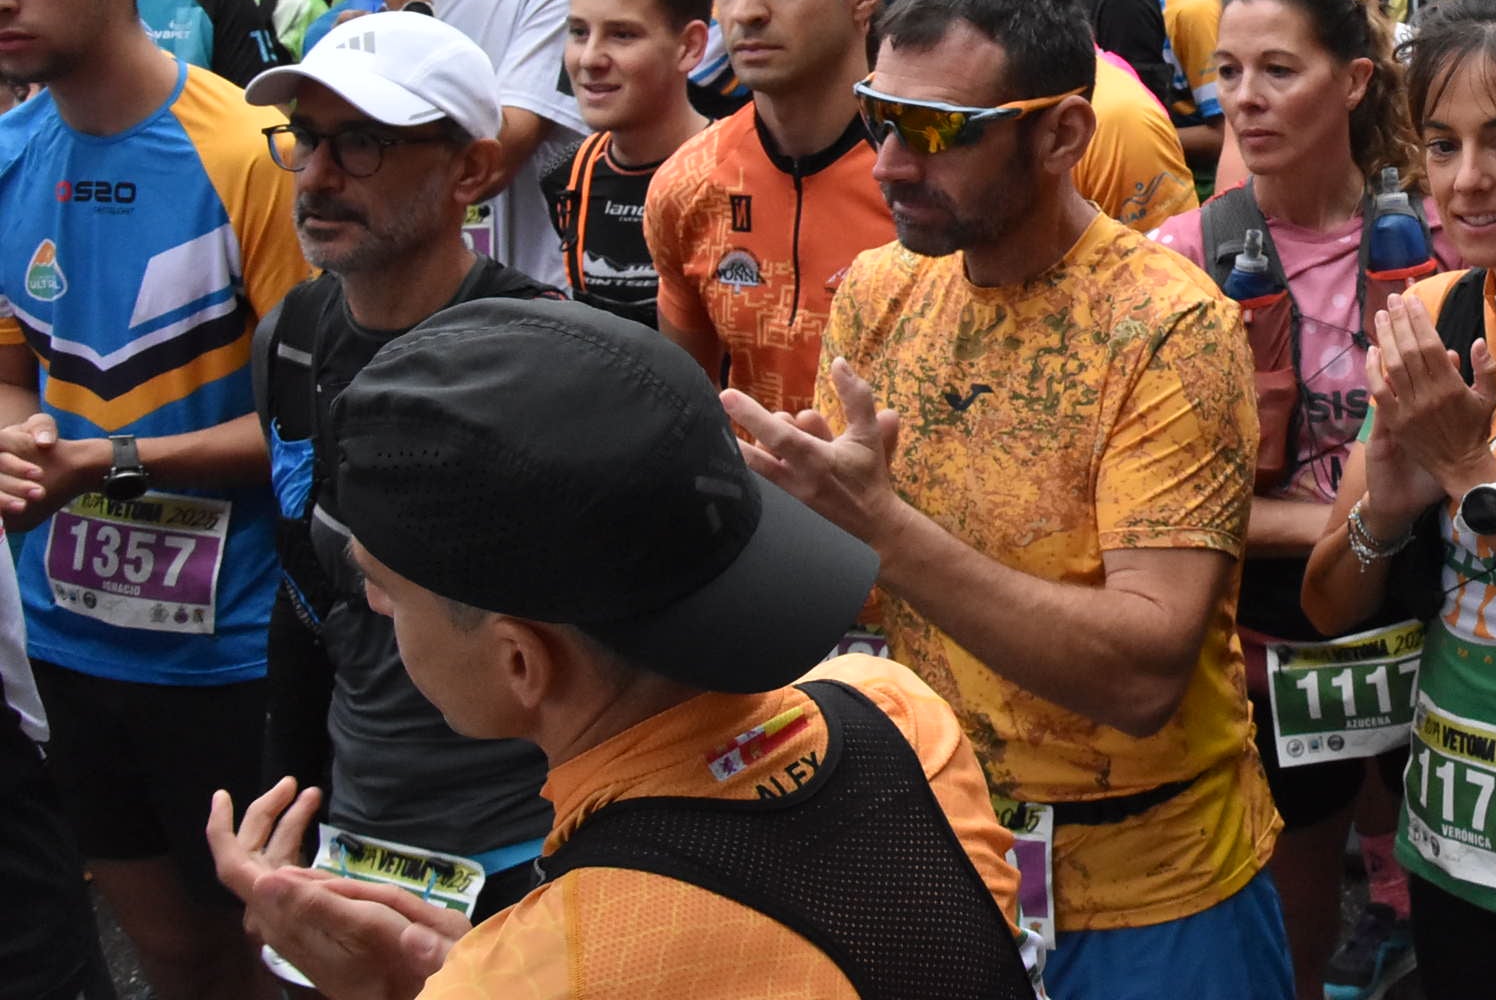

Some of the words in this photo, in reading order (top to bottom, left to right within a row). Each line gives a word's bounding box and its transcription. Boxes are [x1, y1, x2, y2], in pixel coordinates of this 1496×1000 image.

[70, 519, 197, 588] 1357
[102, 580, 142, 597] IGNACIO
[1296, 659, 1421, 720] 1117
[1345, 716, 1392, 730] AZUCENA
[1442, 724, 1496, 764] VETONA
[1441, 822, 1493, 850] VERÓNICA
